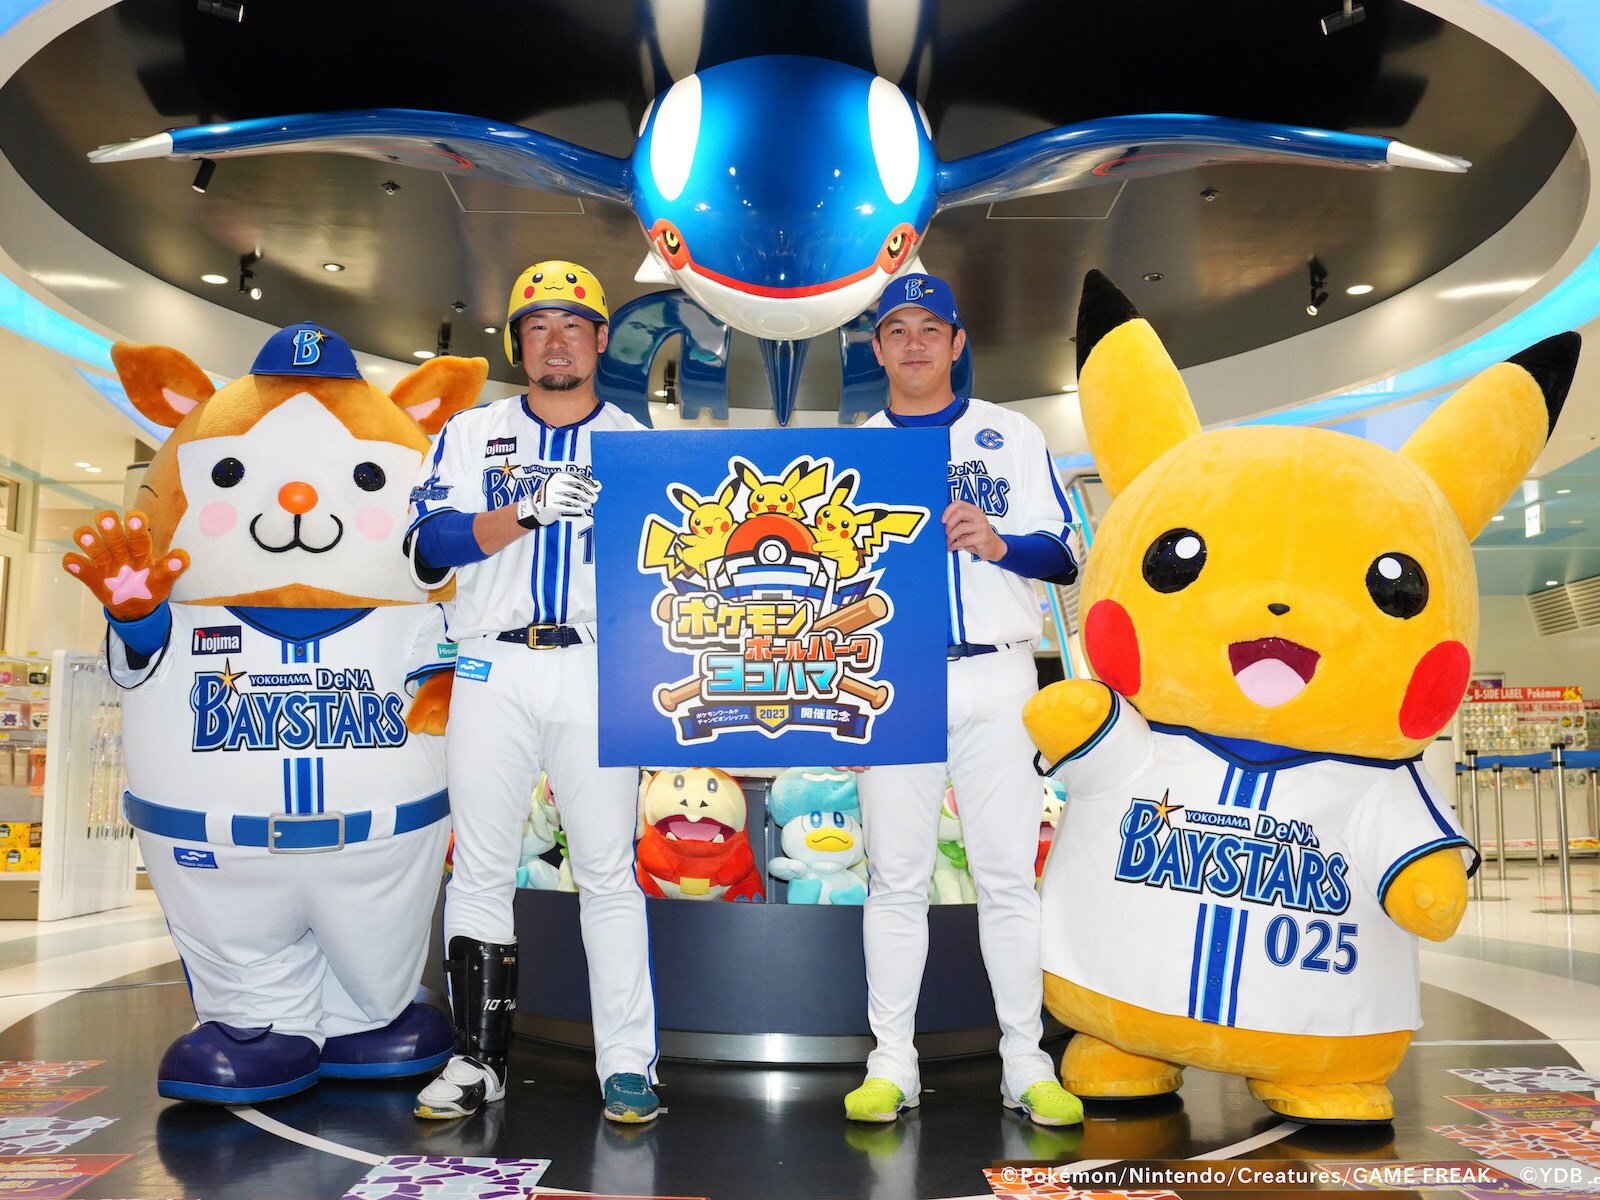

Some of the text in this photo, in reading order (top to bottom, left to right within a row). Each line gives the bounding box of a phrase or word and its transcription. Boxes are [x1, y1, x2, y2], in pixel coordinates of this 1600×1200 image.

[486, 441, 515, 456] ojima
[947, 475, 1010, 518] TARS
[677, 595, 807, 636] ポケモン
[193, 630, 240, 652] nojima
[744, 629, 869, 661] ボールパーク
[248, 668, 375, 692] YOKOHAMA DeNA
[707, 656, 837, 693] ヨコハマ
[1473, 687, 1562, 700] B-SIDE LABEL Pokémon
[191, 671, 408, 752] BAYSTARS
[759, 709, 786, 719] 2023
[800, 707, 851, 722] 開催記念
[1185, 809, 1320, 848] YOKOHAMA DeNA
[1115, 798, 1351, 916] BAYSTARS
[1264, 914, 1359, 975] 025
[483, 998, 501, 1010] 10
